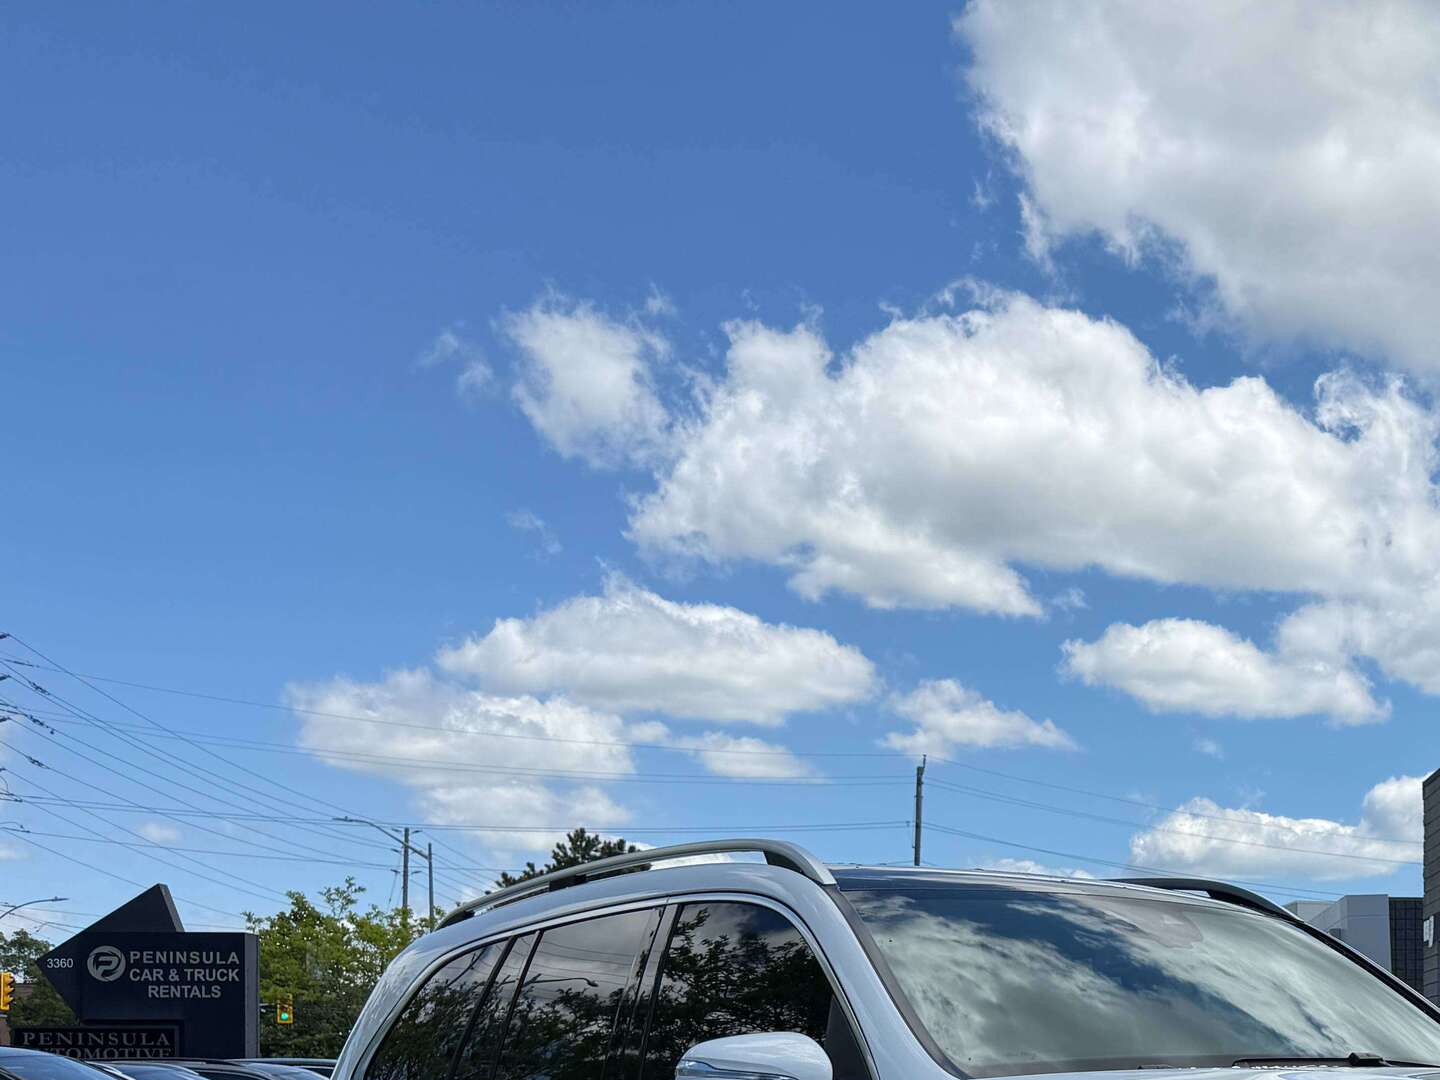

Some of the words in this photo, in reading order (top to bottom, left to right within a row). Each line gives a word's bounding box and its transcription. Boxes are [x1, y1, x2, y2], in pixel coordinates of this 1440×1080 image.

[46, 957, 74, 969] 3360
[129, 951, 240, 965] PENINSULA
[129, 968, 164, 982] CAR
[168, 968, 180, 982] &
[184, 968, 240, 982] TRUCK
[148, 985, 222, 998] RENTALS
[22, 1032, 170, 1046] PENINSULA
